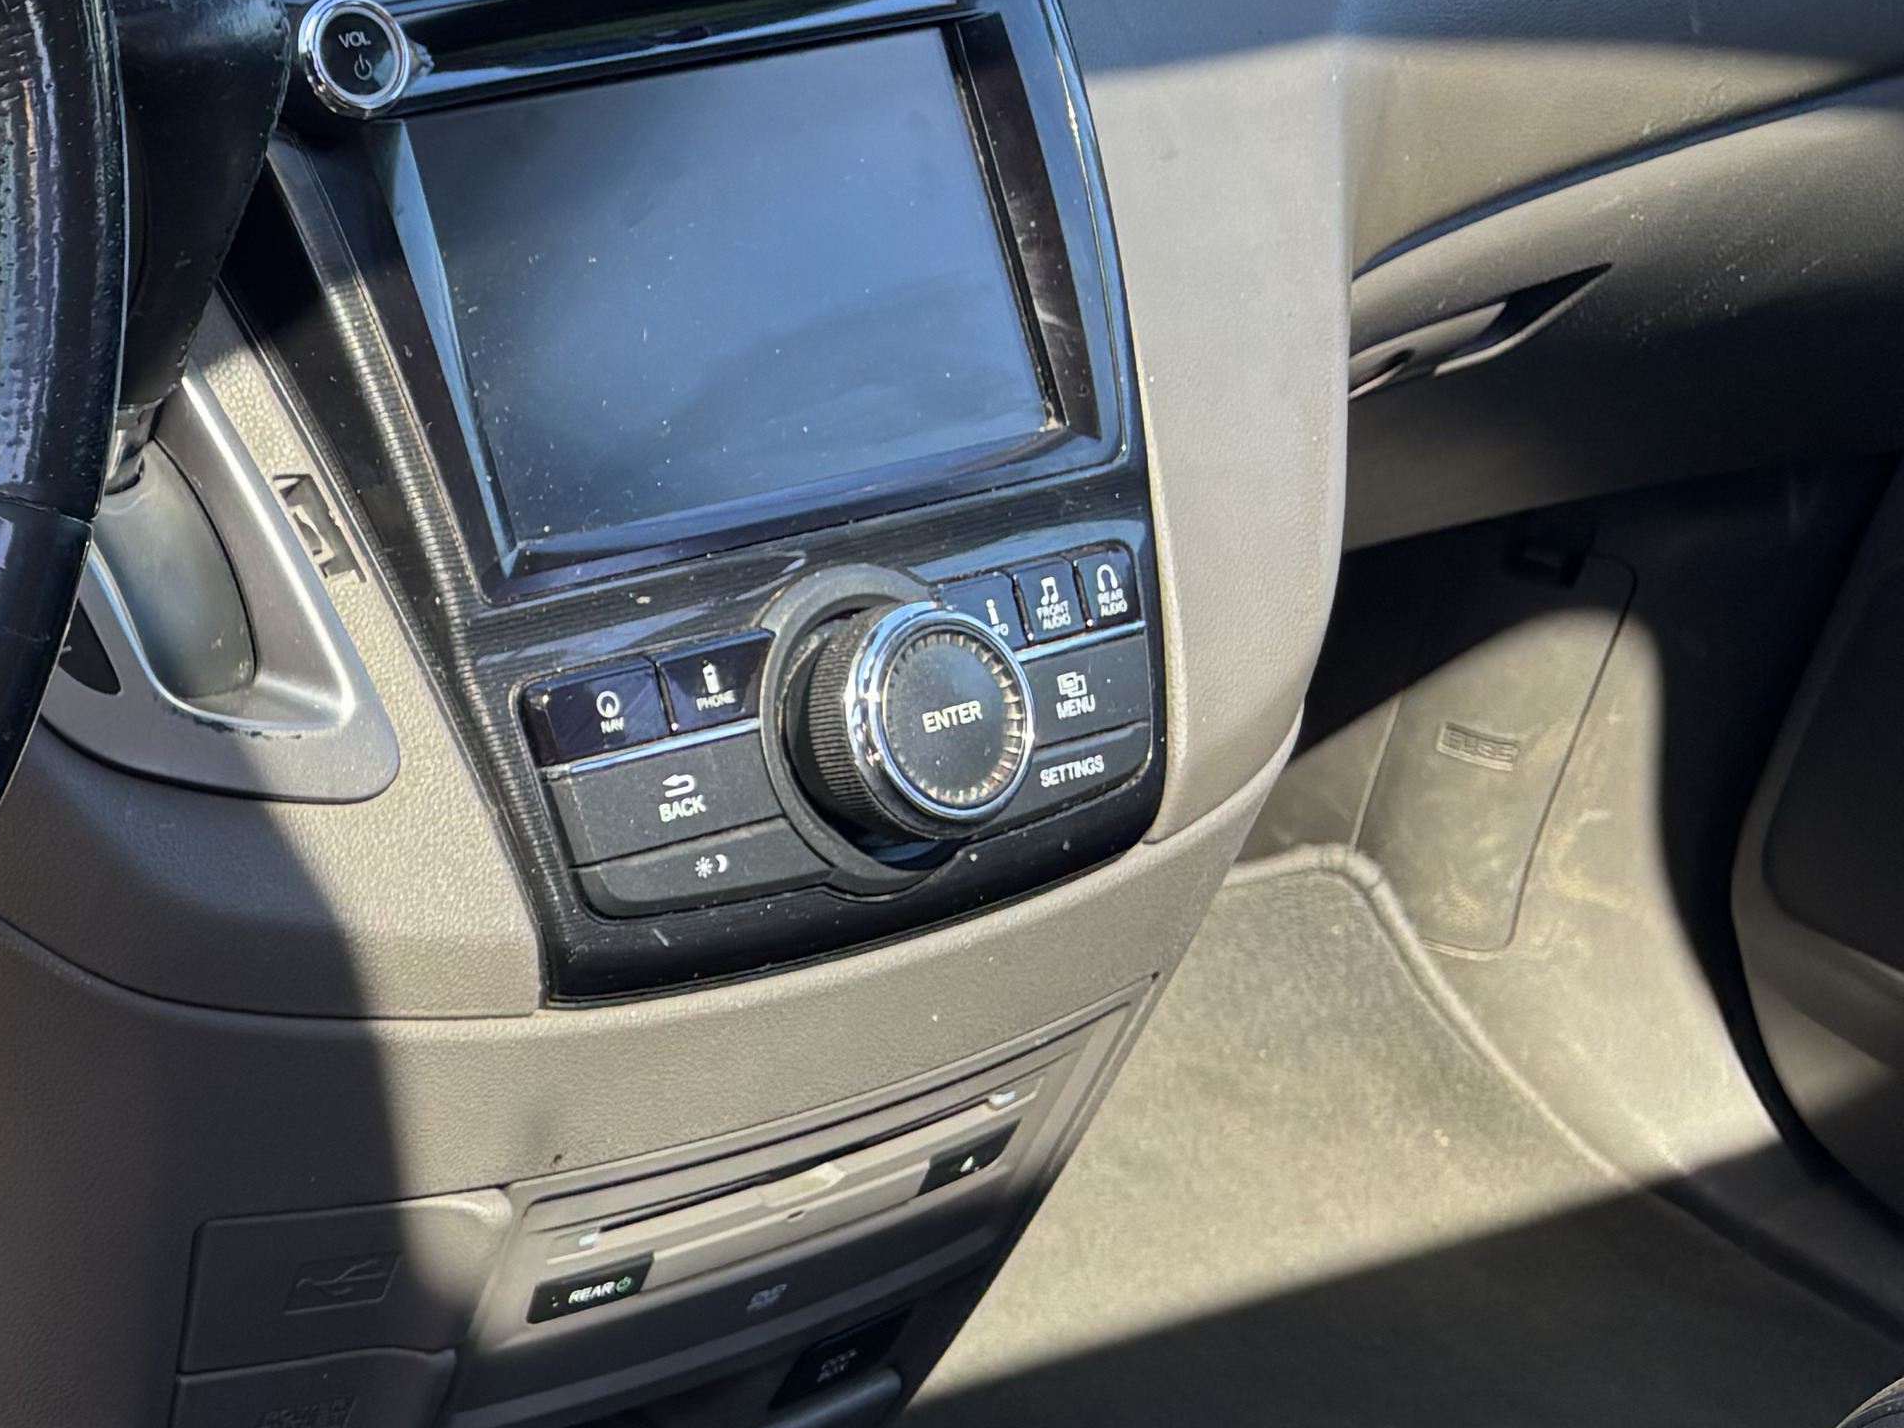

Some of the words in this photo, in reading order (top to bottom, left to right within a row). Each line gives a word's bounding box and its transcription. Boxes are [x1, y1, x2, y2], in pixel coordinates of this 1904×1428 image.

[338, 31, 371, 48] VOL
[1097, 588, 1124, 605] REAR
[1036, 600, 1069, 620] FRONT
[1100, 600, 1128, 617] AUDIO
[1043, 614, 1071, 630] AUDIO
[696, 690, 736, 711] PHONE
[1055, 694, 1096, 720] MENU
[600, 717, 624, 734] NAV
[922, 699, 983, 733] ENTER
[1444, 729, 1518, 763] FUSE
[1039, 754, 1105, 788] SETTINGS
[659, 794, 706, 822] BACK
[568, 1281, 616, 1304] REAR
